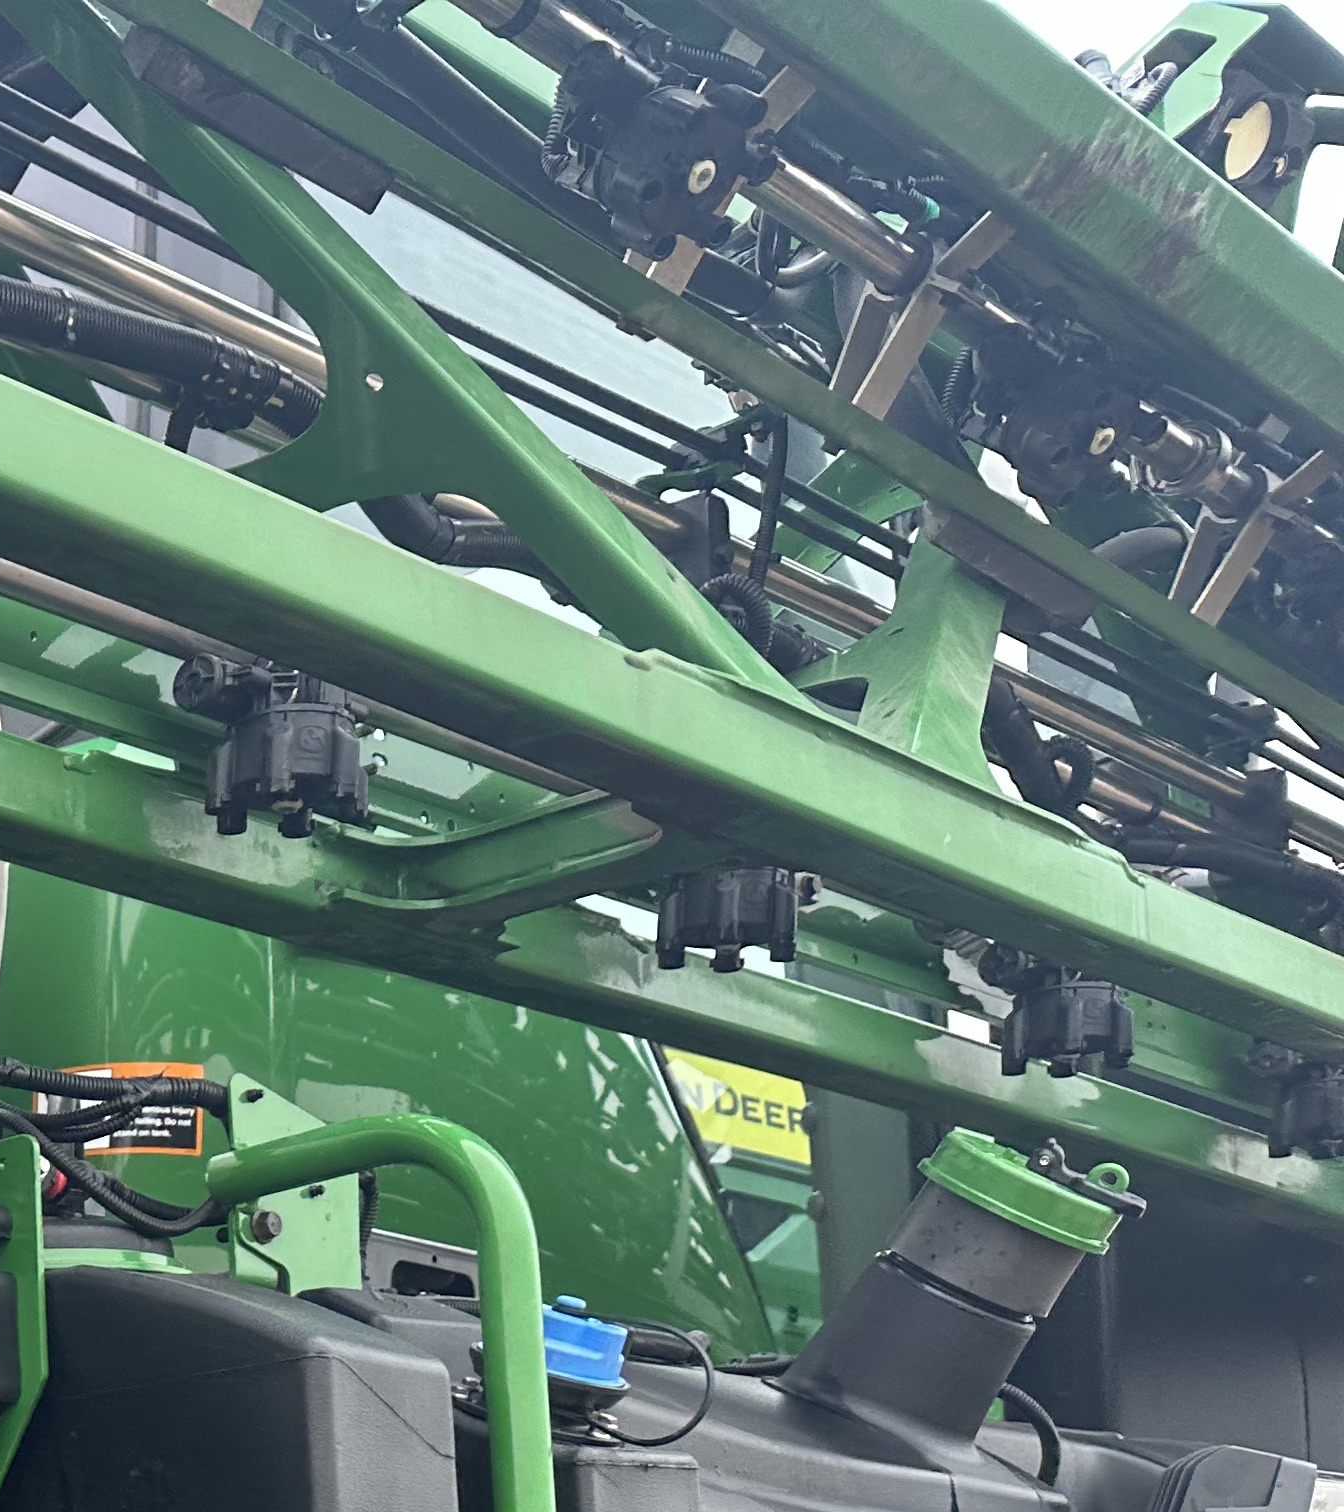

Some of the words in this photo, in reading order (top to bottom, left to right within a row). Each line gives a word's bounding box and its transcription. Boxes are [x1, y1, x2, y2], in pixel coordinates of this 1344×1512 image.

[142, 1106, 171, 1114] erious
[172, 1106, 195, 1117] injury
[713, 1081, 805, 1132] DEER
[164, 1117, 177, 1126] Do
[177, 1118, 192, 1126] not
[138, 1129, 150, 1137] on
[151, 1129, 172, 1138] tank.
